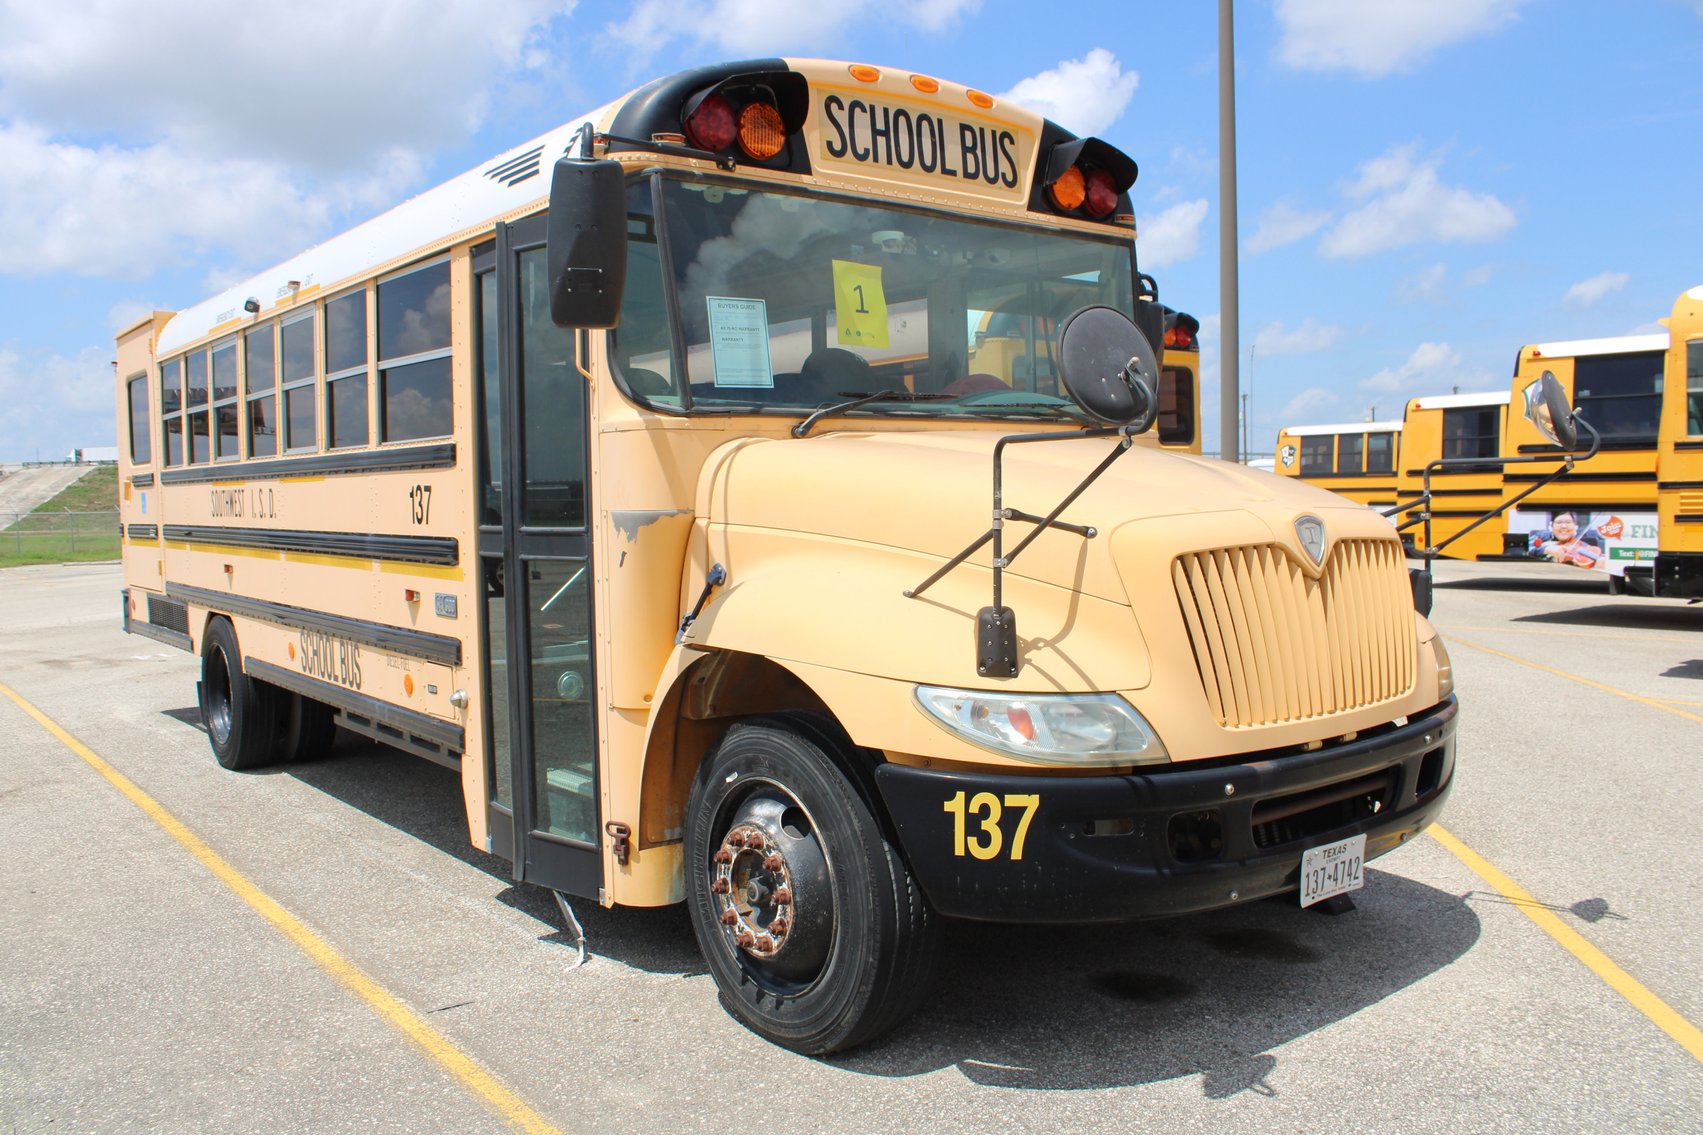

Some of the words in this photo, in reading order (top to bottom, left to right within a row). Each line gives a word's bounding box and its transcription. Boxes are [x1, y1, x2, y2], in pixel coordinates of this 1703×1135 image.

[824, 95, 957, 177] SCHOOL
[959, 122, 1018, 189] BUS
[853, 284, 869, 314] 1
[211, 489, 245, 518] SOUTHWEST
[409, 484, 432, 525] 137
[300, 628, 339, 683] SCHOOL
[340, 638, 362, 691] BUS
[943, 790, 1040, 861] 137
[1322, 843, 1348, 860] TEXAS
